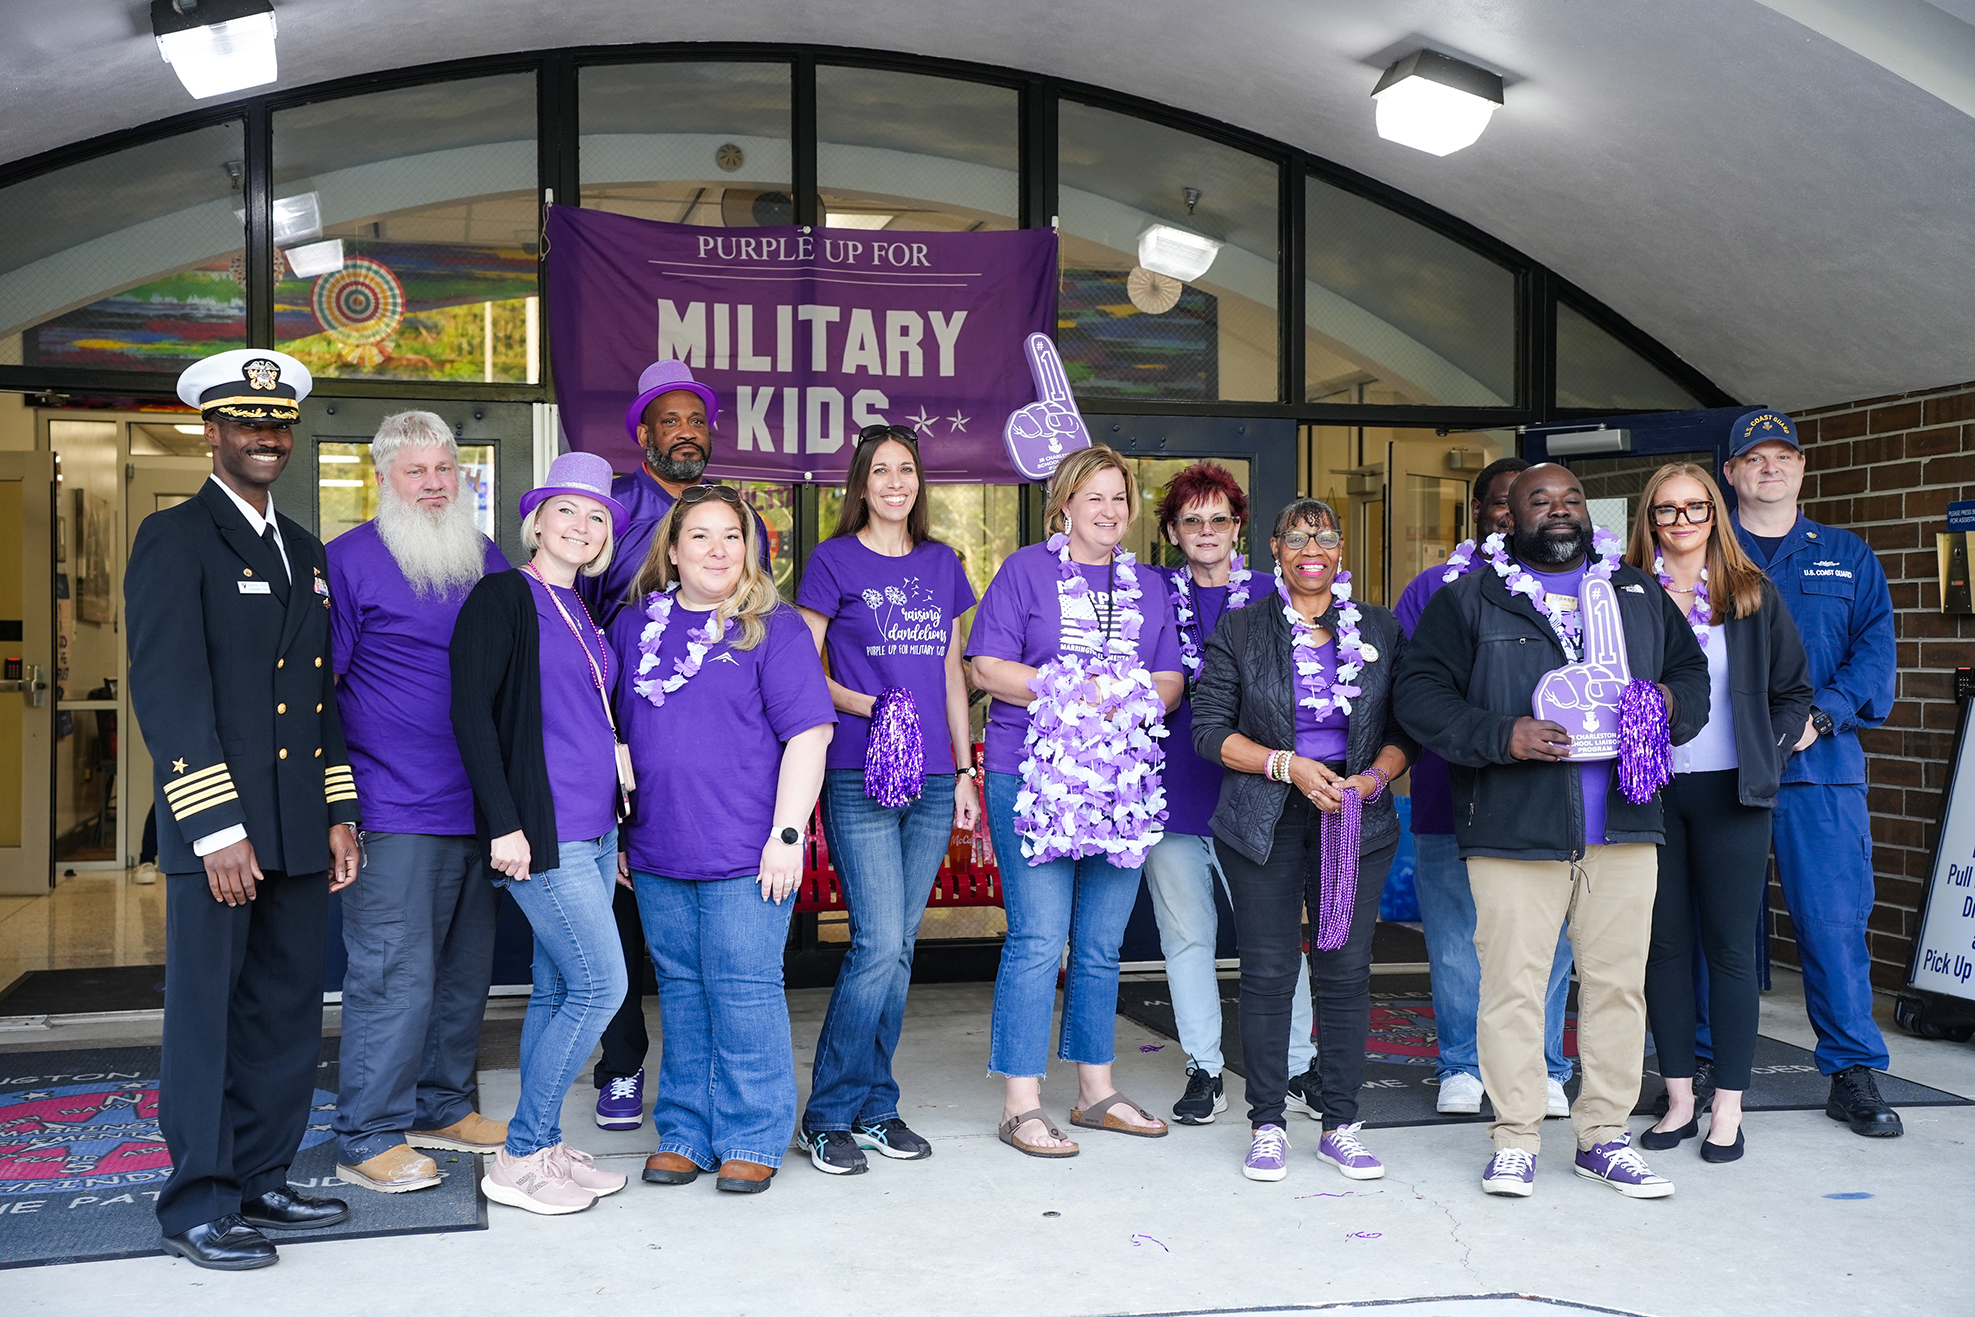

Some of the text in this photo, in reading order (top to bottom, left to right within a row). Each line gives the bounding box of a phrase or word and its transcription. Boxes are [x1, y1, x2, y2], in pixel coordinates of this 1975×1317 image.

[697, 236, 931, 266] PURPLE UP FOR
[657, 298, 968, 377] MILITARY
[736, 385, 889, 455] KIDS
[1750, 414, 1773, 427] COAST
[1773, 416, 1790, 434] GUARD
[1834, 569, 1853, 579] GUARD
[901, 607, 942, 628] raising
[888, 623, 947, 644] dandelions
[866, 645, 886, 656] PURPLE
[888, 644, 897, 655] UP
[898, 644, 909, 655] FOR
[909, 644, 935, 656] MILITARY
[1576, 732, 1617, 741] CHARLESTON
[1577, 745, 1613, 754] PROGRAM
[1947, 863, 1974, 888] Pull
[1923, 949, 1973, 984] Pick Up
